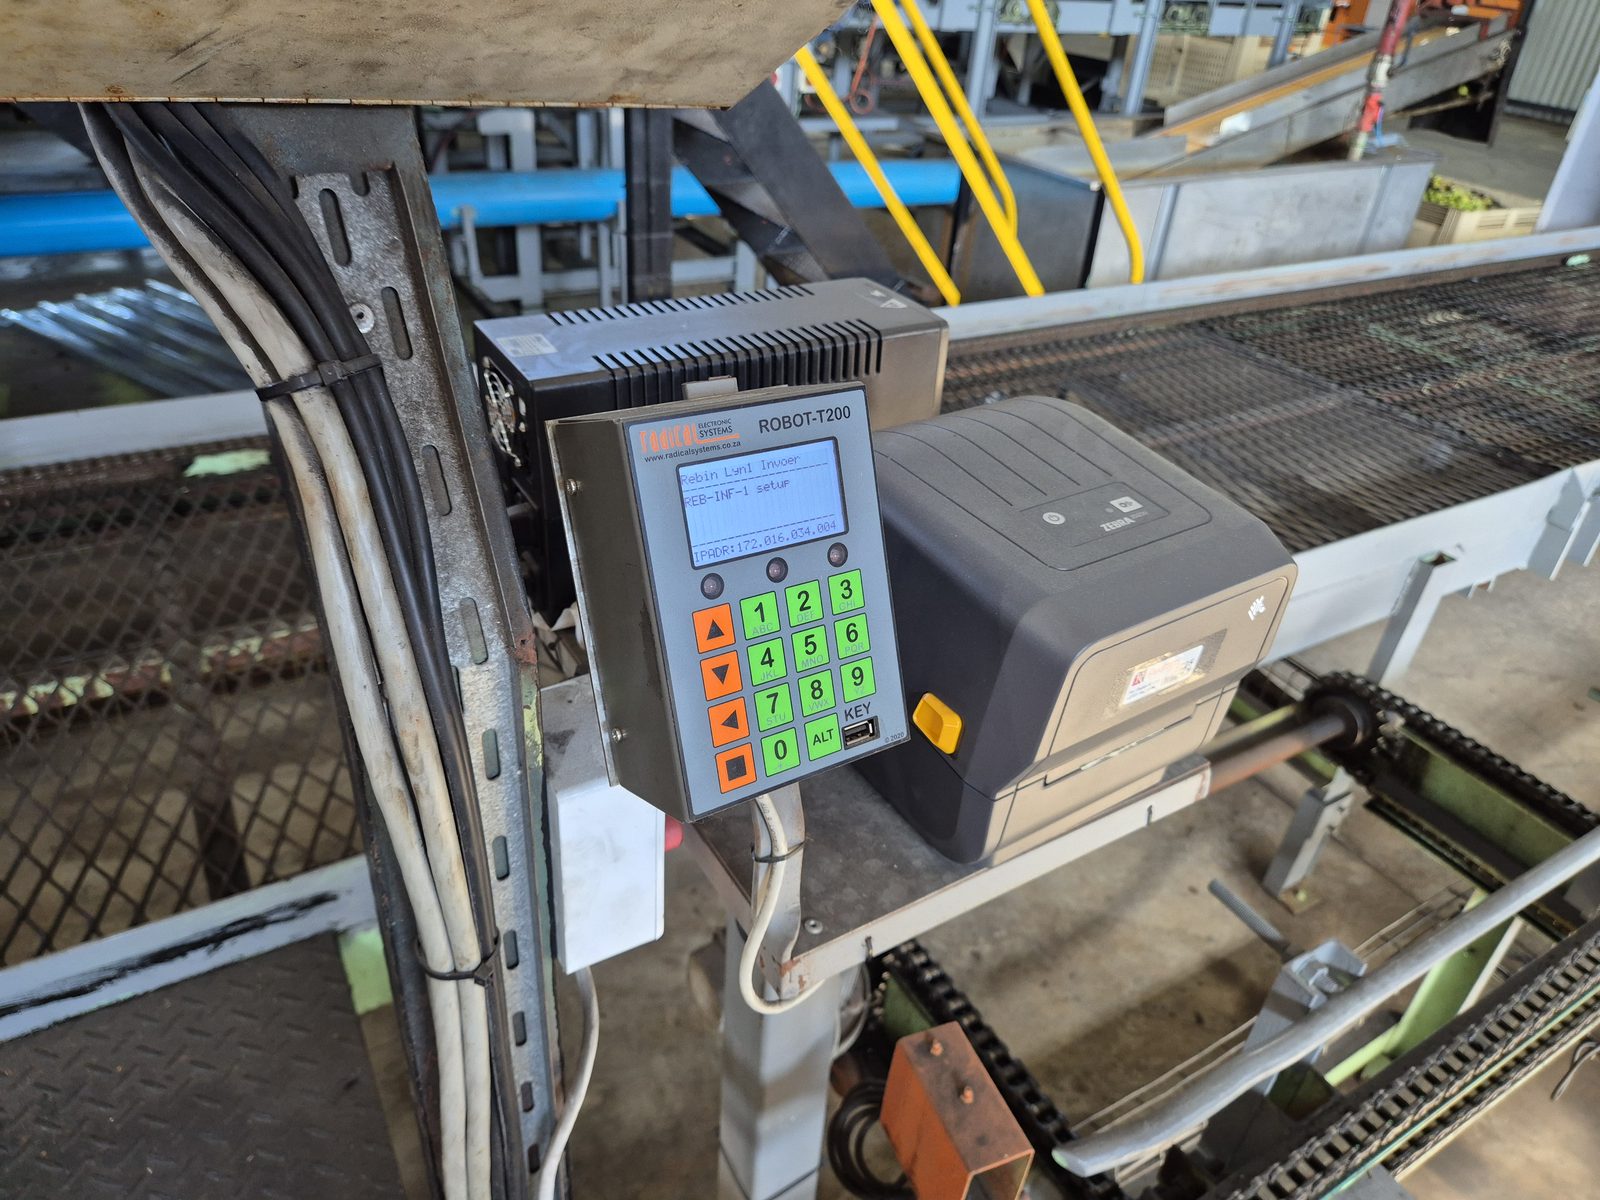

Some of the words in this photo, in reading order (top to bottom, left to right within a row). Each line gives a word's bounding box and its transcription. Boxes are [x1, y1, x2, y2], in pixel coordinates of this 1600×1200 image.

[698, 418, 732, 429] ELECTRONIC
[759, 405, 851, 433] ROBOT-T200
[699, 426, 733, 438] SYSTEMS
[644, 441, 741, 463] www.radicalsystems.co.za
[681, 471, 718, 485] Rebin
[761, 455, 800, 470] Invoer
[684, 486, 749, 507] REB-INF-1
[1100, 517, 1136, 531] ZEBRA
[694, 520, 836, 563] IPADR:172.016.034.004
[840, 579, 853, 599] 3
[797, 590, 811, 611] 2
[838, 600, 856, 611] GHI
[754, 602, 765, 622] 1
[797, 610, 817, 623] DEF
[752, 623, 773, 636] ABC
[846, 622, 858, 642] 6
[804, 634, 817, 655] 5
[760, 647, 774, 667] 4
[801, 655, 823, 668] MNO
[760, 669, 777, 680] JKL
[851, 666, 864, 686] 9
[810, 679, 823, 700] 8
[766, 692, 779, 714] 7
[844, 701, 871, 721] KEY
[766, 712, 786, 726] STU
[813, 728, 834, 746] ALT
[890, 731, 905, 741] 2020
[774, 739, 787, 760] 0
